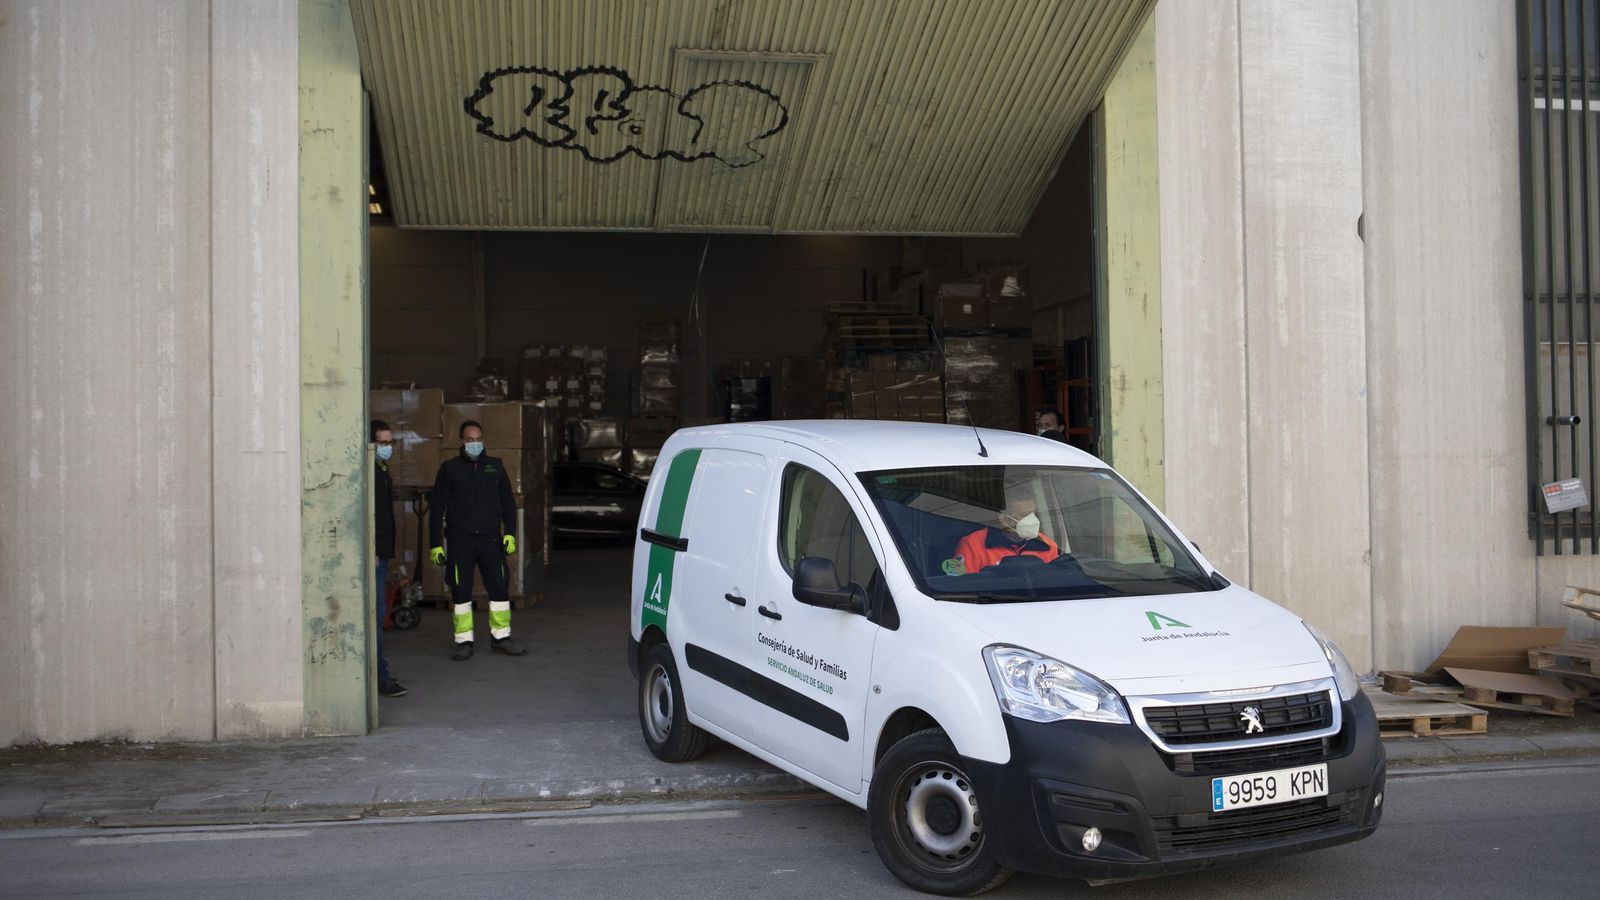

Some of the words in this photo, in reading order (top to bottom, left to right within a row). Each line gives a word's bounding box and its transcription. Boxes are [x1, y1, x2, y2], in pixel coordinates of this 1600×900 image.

[1140, 634, 1169, 642] Junta
[1183, 629, 1230, 638] Andalucía
[757, 632, 787, 654] Consejería
[787, 645, 796, 658] de
[796, 649, 814, 665] Salud
[814, 659, 820, 670] y
[820, 658, 847, 680] Familias
[767, 657, 788, 674] SERVICIO
[788, 665, 809, 684] ANDALUZ
[809, 676, 817, 688] DE
[816, 680, 834, 695] SALUD
[1215, 797, 1221, 805] E
[1229, 776, 1277, 805] 9959
[1291, 769, 1324, 796] KPN
